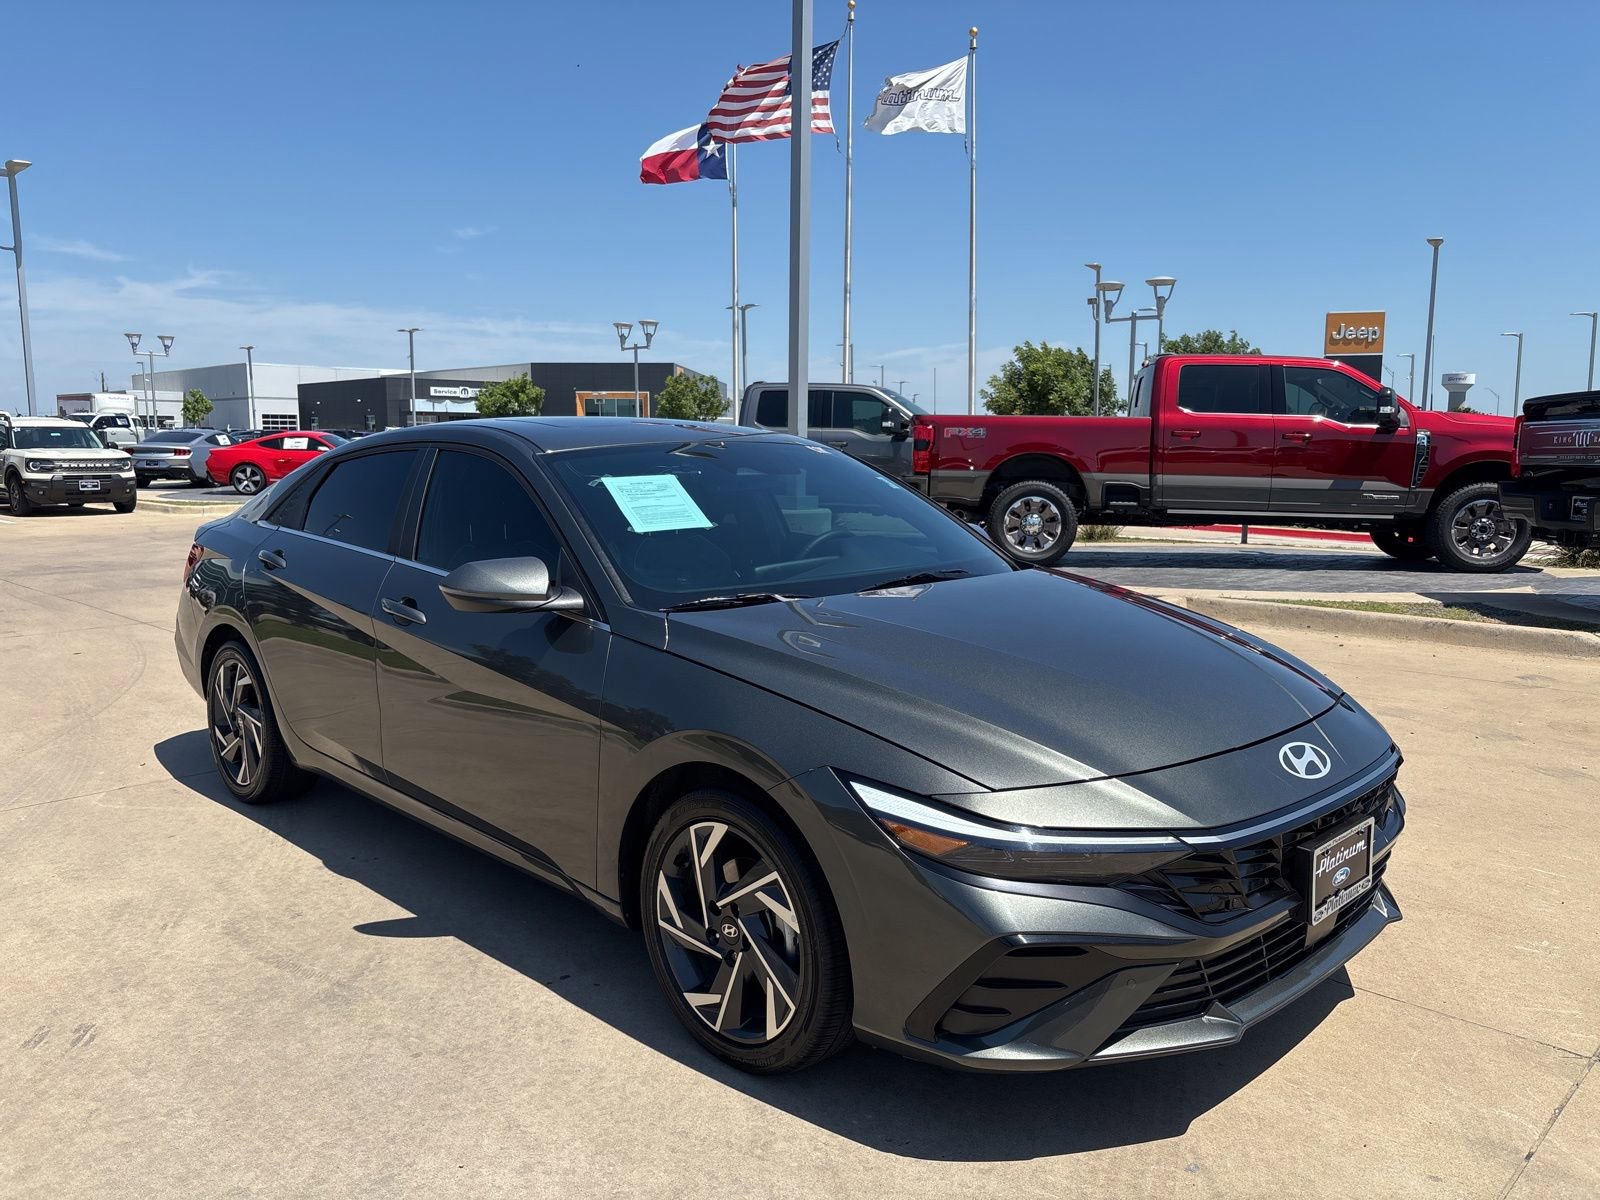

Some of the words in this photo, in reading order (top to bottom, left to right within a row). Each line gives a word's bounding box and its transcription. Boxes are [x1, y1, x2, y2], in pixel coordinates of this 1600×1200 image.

[1331, 323, 1380, 342] Jeep
[943, 427, 986, 439] FX4
[1553, 435, 1572, 444] KING
[1315, 839, 1367, 878] Platinum
[1332, 868, 1349, 886] Ford
